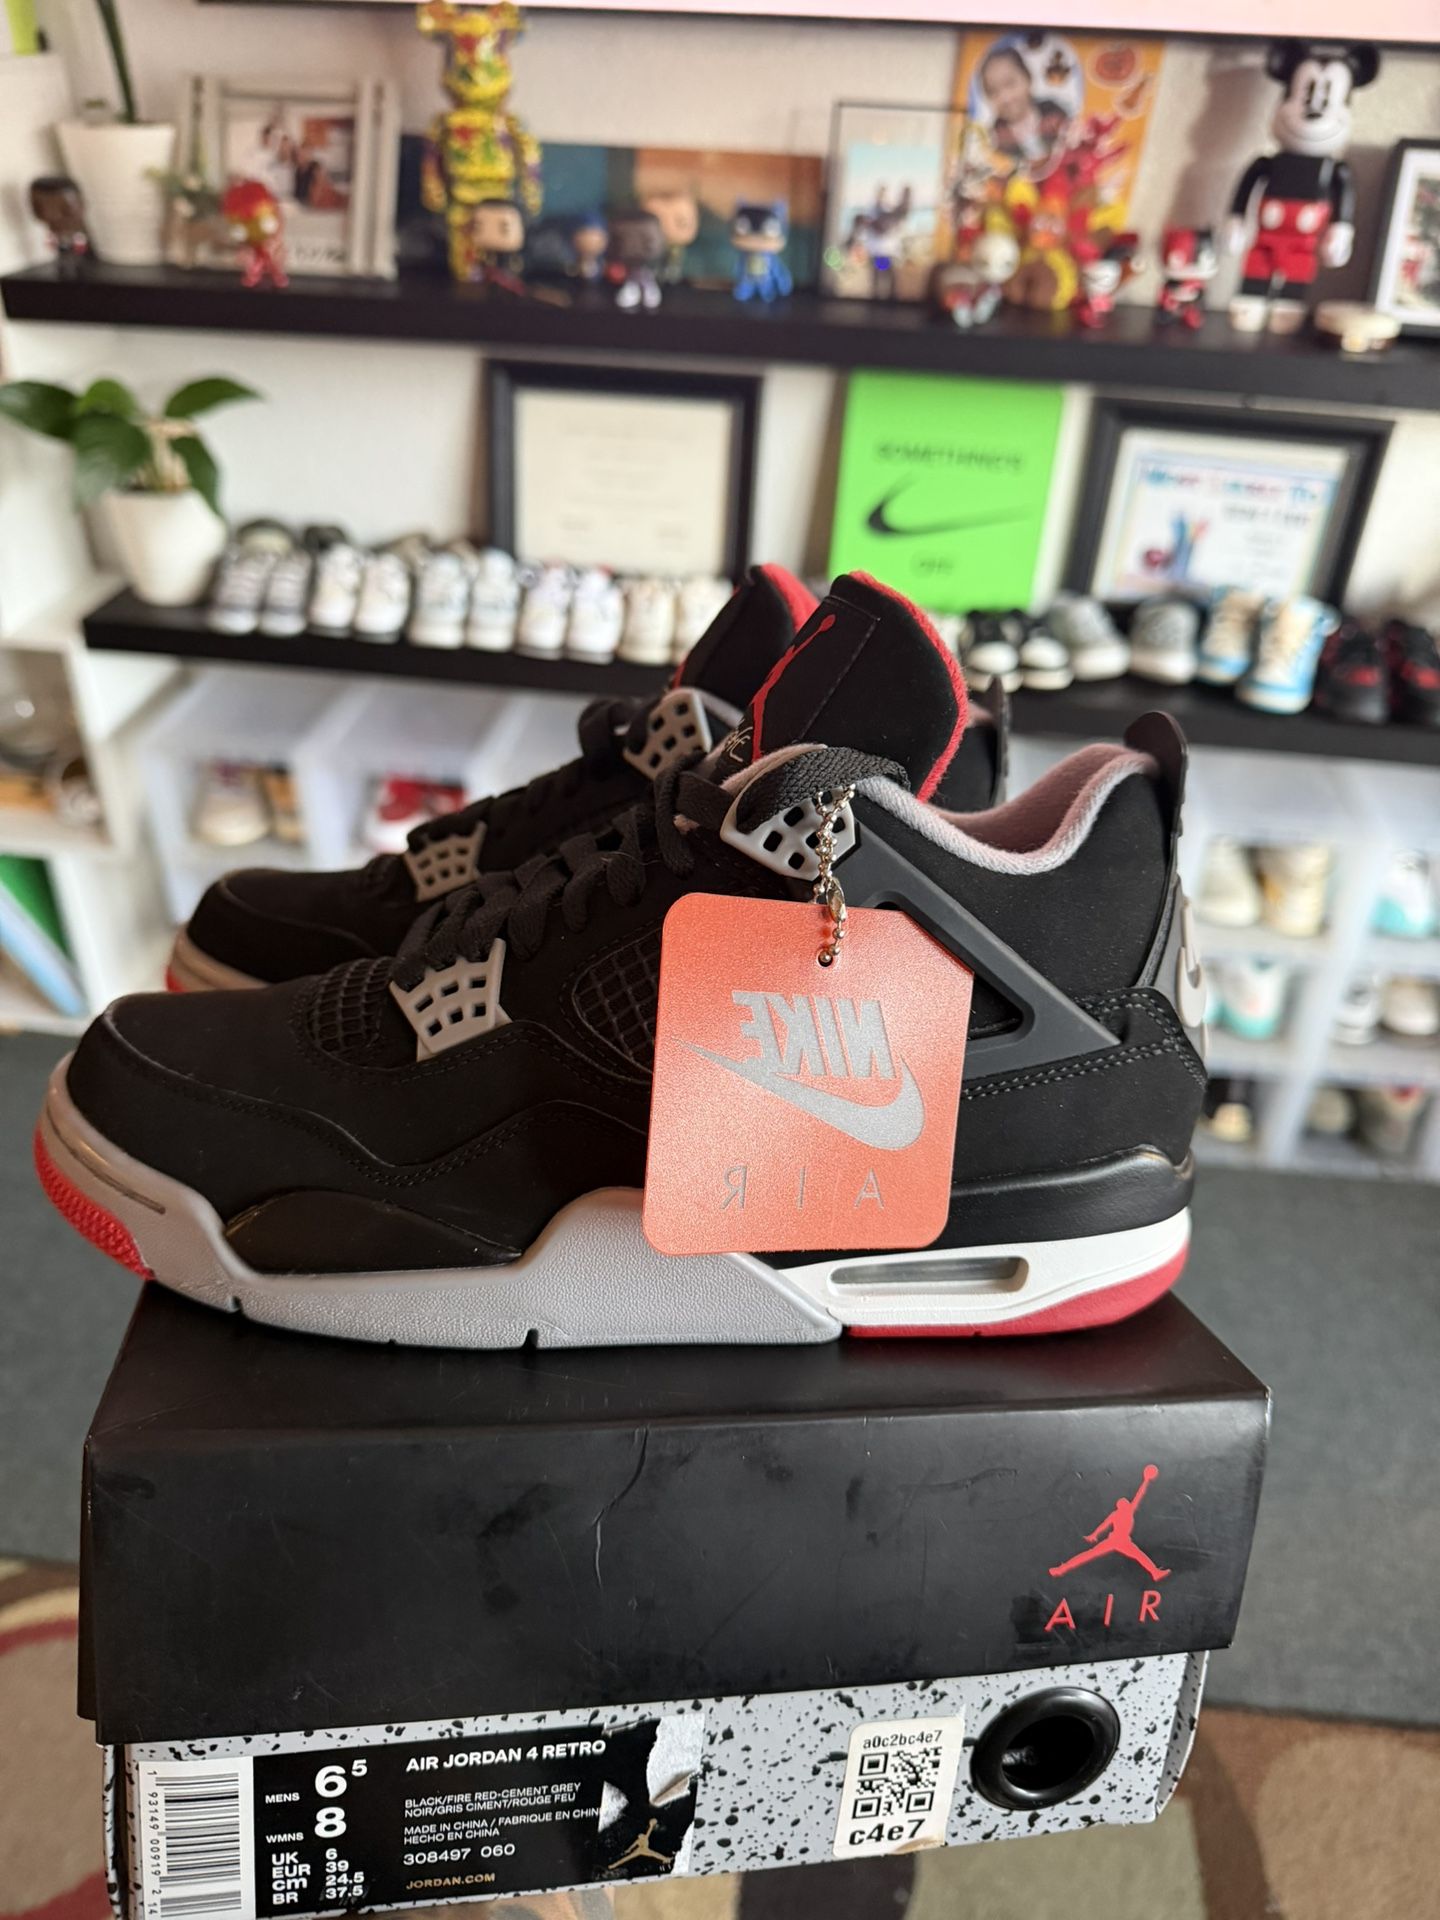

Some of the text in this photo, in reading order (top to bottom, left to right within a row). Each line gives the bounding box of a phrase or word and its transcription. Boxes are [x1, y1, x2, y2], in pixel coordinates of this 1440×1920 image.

[1044, 1590, 1161, 1632] AIR
[863, 1729, 942, 1749] a0c2bc4e7
[406, 1739, 606, 1772] AIR JORDAN 4 RETRO
[265, 1792, 300, 1804] MENS
[404, 1792, 576, 1818] NOIR/GRIS CIMENT/ROUGE FEU
[405, 1781, 581, 1809] BLACK/FIRE RED-CEMENT GREY
[148, 1792, 159, 1830] 93149
[404, 1824, 437, 1836] MADE
[440, 1822, 451, 1832] IN
[453, 1818, 489, 1831] CHINA
[498, 1811, 552, 1826] FABRIQUE
[555, 1810, 570, 1820] EN
[572, 1807, 601, 1818] CHIN
[266, 1806, 347, 1844] WMNS 8
[404, 1827, 500, 1845] HECHO EN CHINA
[848, 1818, 926, 1845] c4e7
[150, 1839, 161, 1876] 00919
[272, 1848, 338, 1865] UK 6
[403, 1844, 515, 1866] 308497 060
[272, 1860, 349, 1879] EUR 39
[272, 1871, 365, 1891] cm 24.5
[406, 1872, 496, 1890] JORDAN.COM
[272, 1885, 364, 1905] BR 37.5
